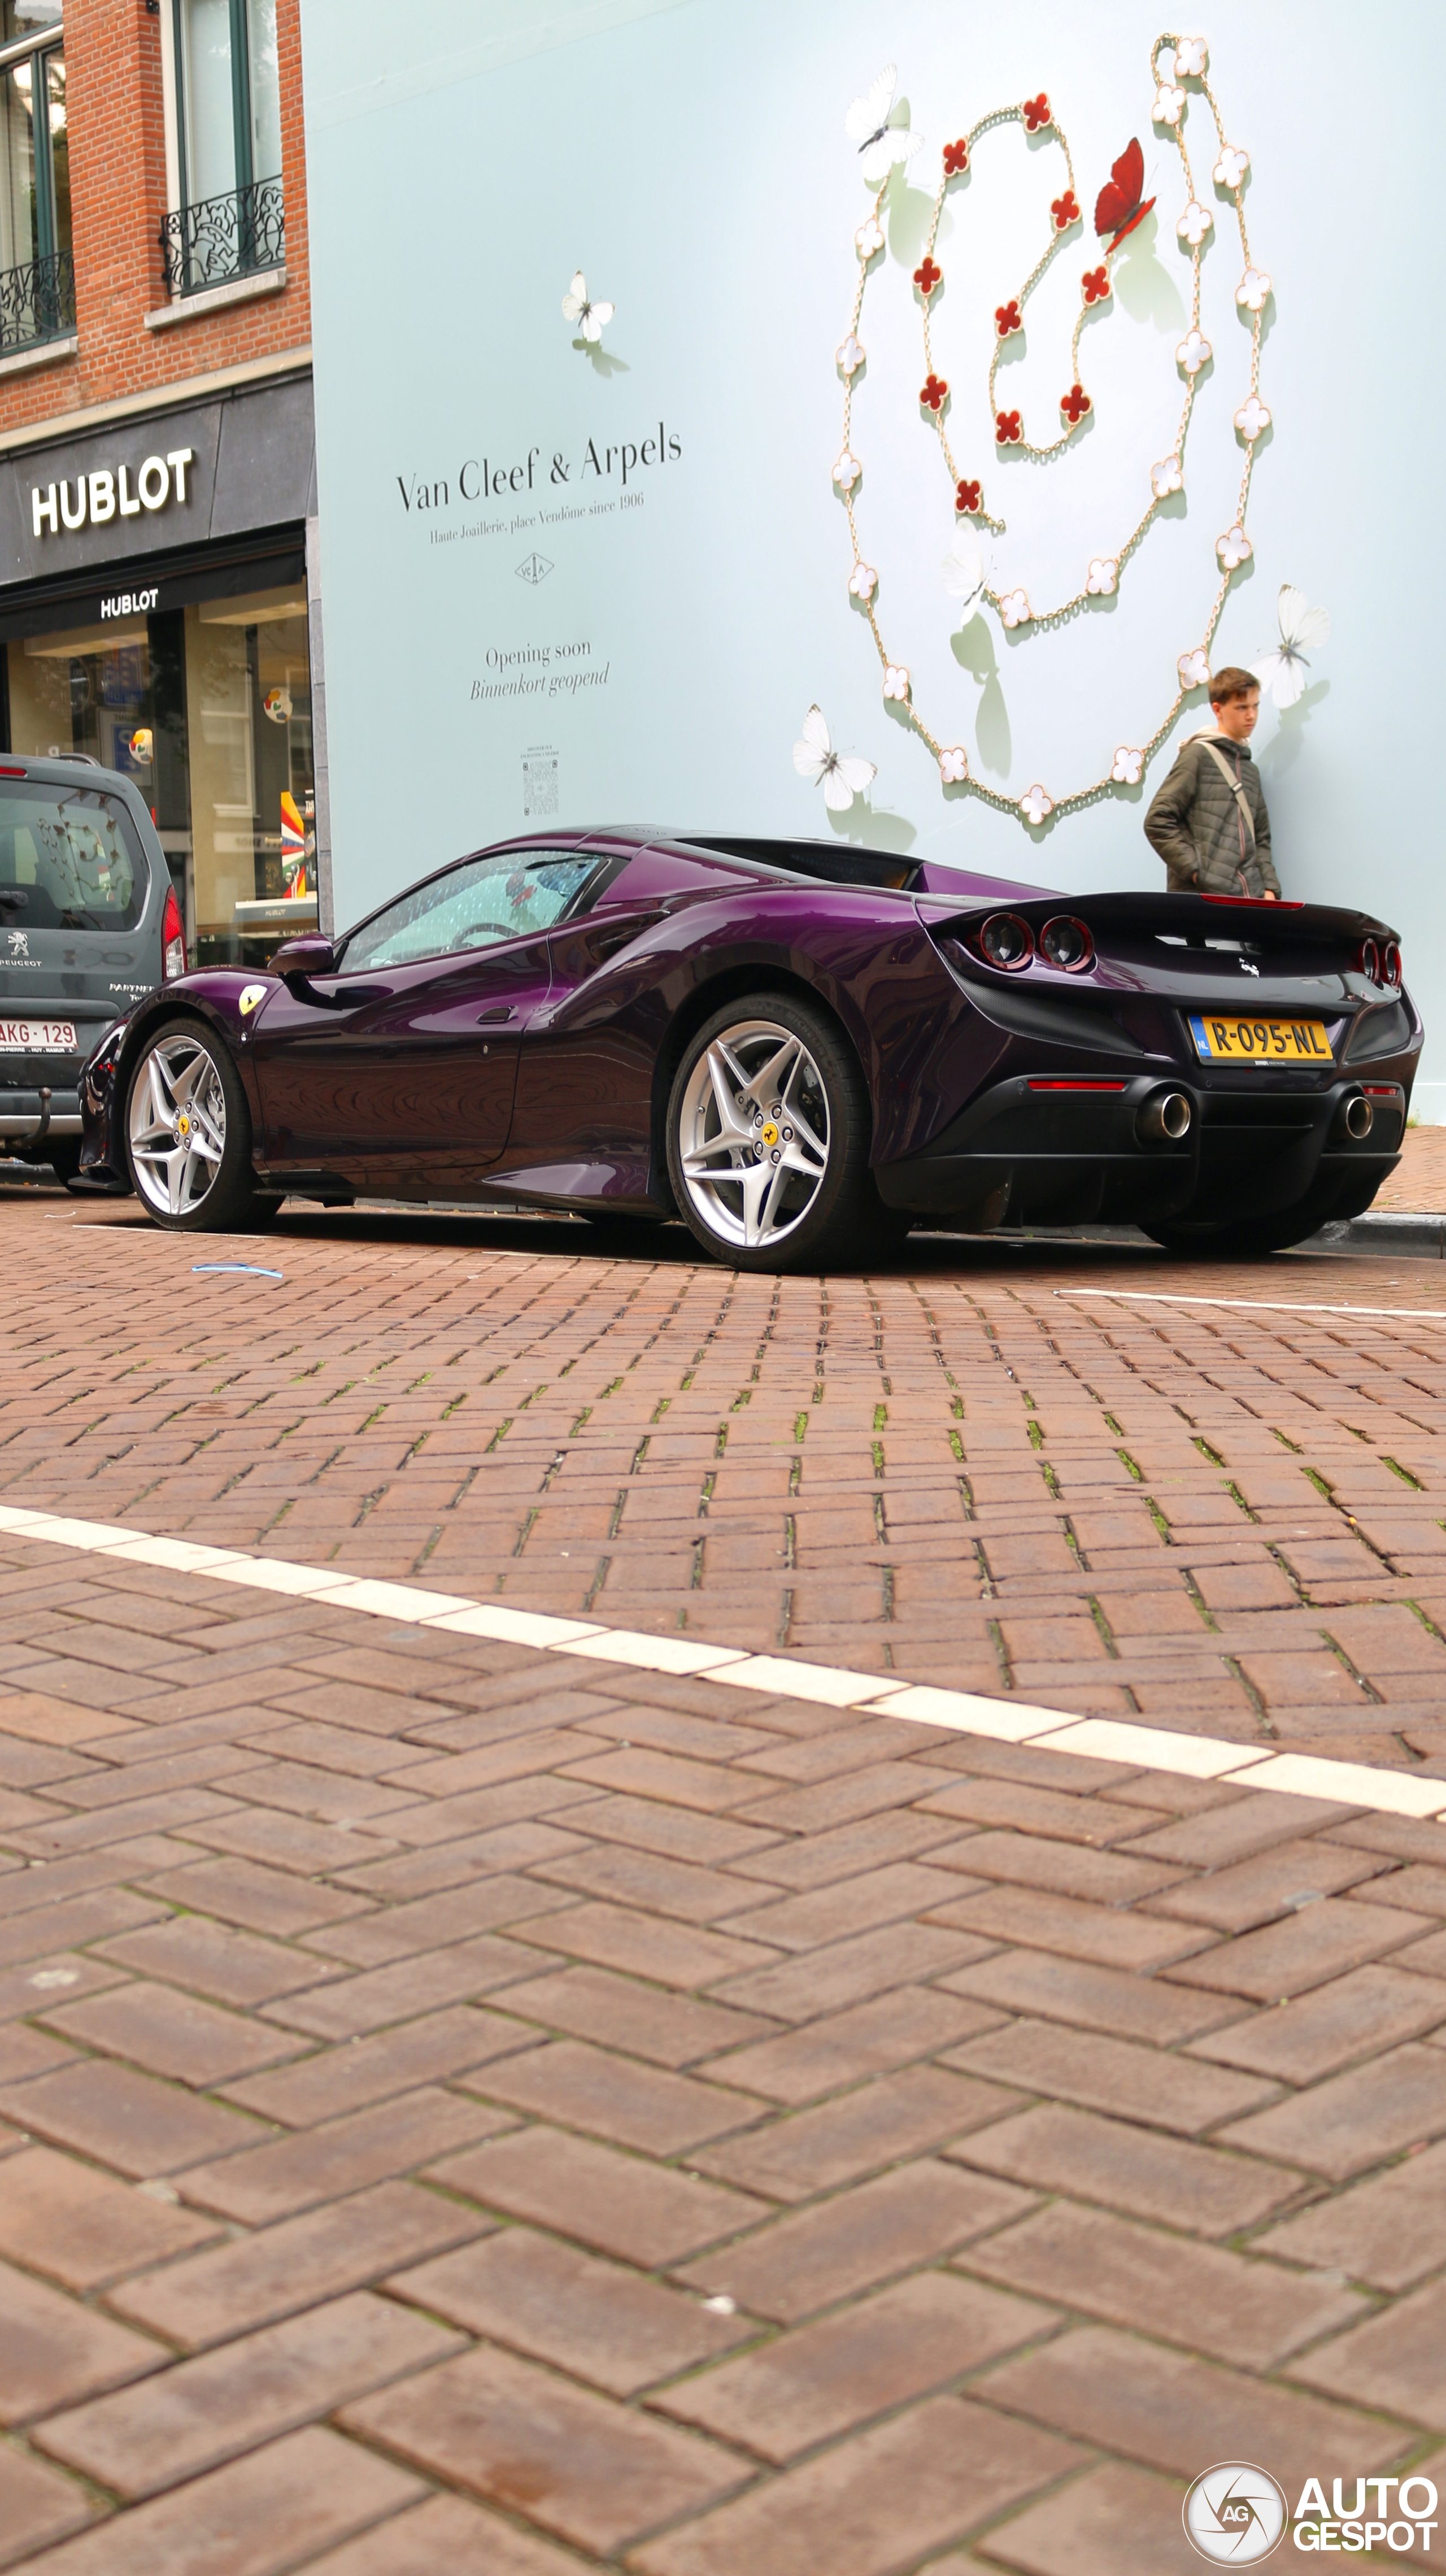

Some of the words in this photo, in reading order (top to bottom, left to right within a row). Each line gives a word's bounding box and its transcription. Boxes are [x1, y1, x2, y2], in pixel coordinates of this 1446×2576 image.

[397, 473, 448, 512] Van
[459, 447, 539, 501] Cleef
[550, 452, 571, 484] &
[580, 421, 682, 485] Arpels
[32, 448, 192, 537] HUBLOT
[430, 530, 458, 544] Haute
[460, 519, 507, 539] Joaillerie,
[510, 515, 535, 534] place
[538, 506, 586, 524] Vendôme
[588, 501, 616, 516] since
[620, 492, 644, 510] 1906
[101, 588, 159, 619] HUBLOT
[486, 643, 551, 673] Opening
[555, 641, 591, 659] soon
[470, 672, 546, 700] Binnenkort
[548, 661, 610, 698] geopend
[1197, 1039, 1209, 1050] NL
[1212, 1022, 1326, 1054] R-095-NL
